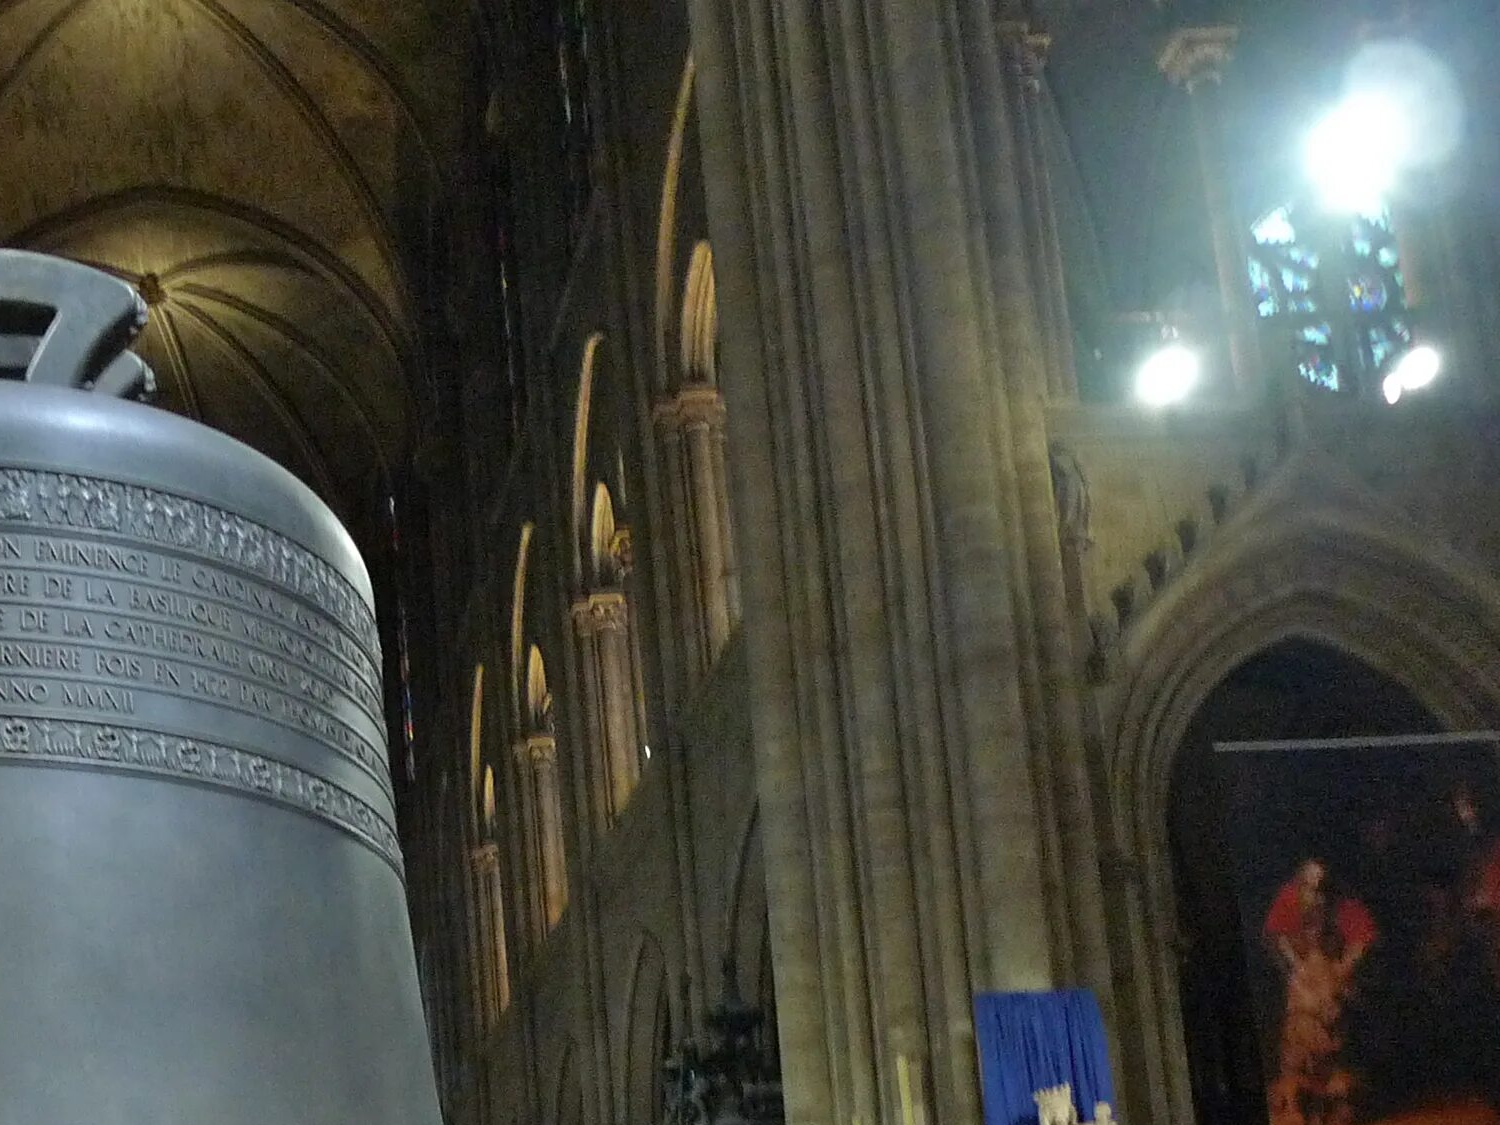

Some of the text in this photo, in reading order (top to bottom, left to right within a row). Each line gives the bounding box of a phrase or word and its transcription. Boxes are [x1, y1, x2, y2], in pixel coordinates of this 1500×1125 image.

[34, 539, 149, 577] EMINENCE
[160, 557, 181, 581] LE
[44, 575, 72, 597] DE
[85, 580, 116, 605] LA
[129, 589, 233, 633] BASILIQUE
[20, 610, 49, 632] DE
[63, 614, 94, 638] LA
[105, 623, 241, 668] CATHEDRALE
[95, 654, 143, 679] FOIS
[154, 661, 181, 686] EN
[62, 688, 136, 714] MMXII
